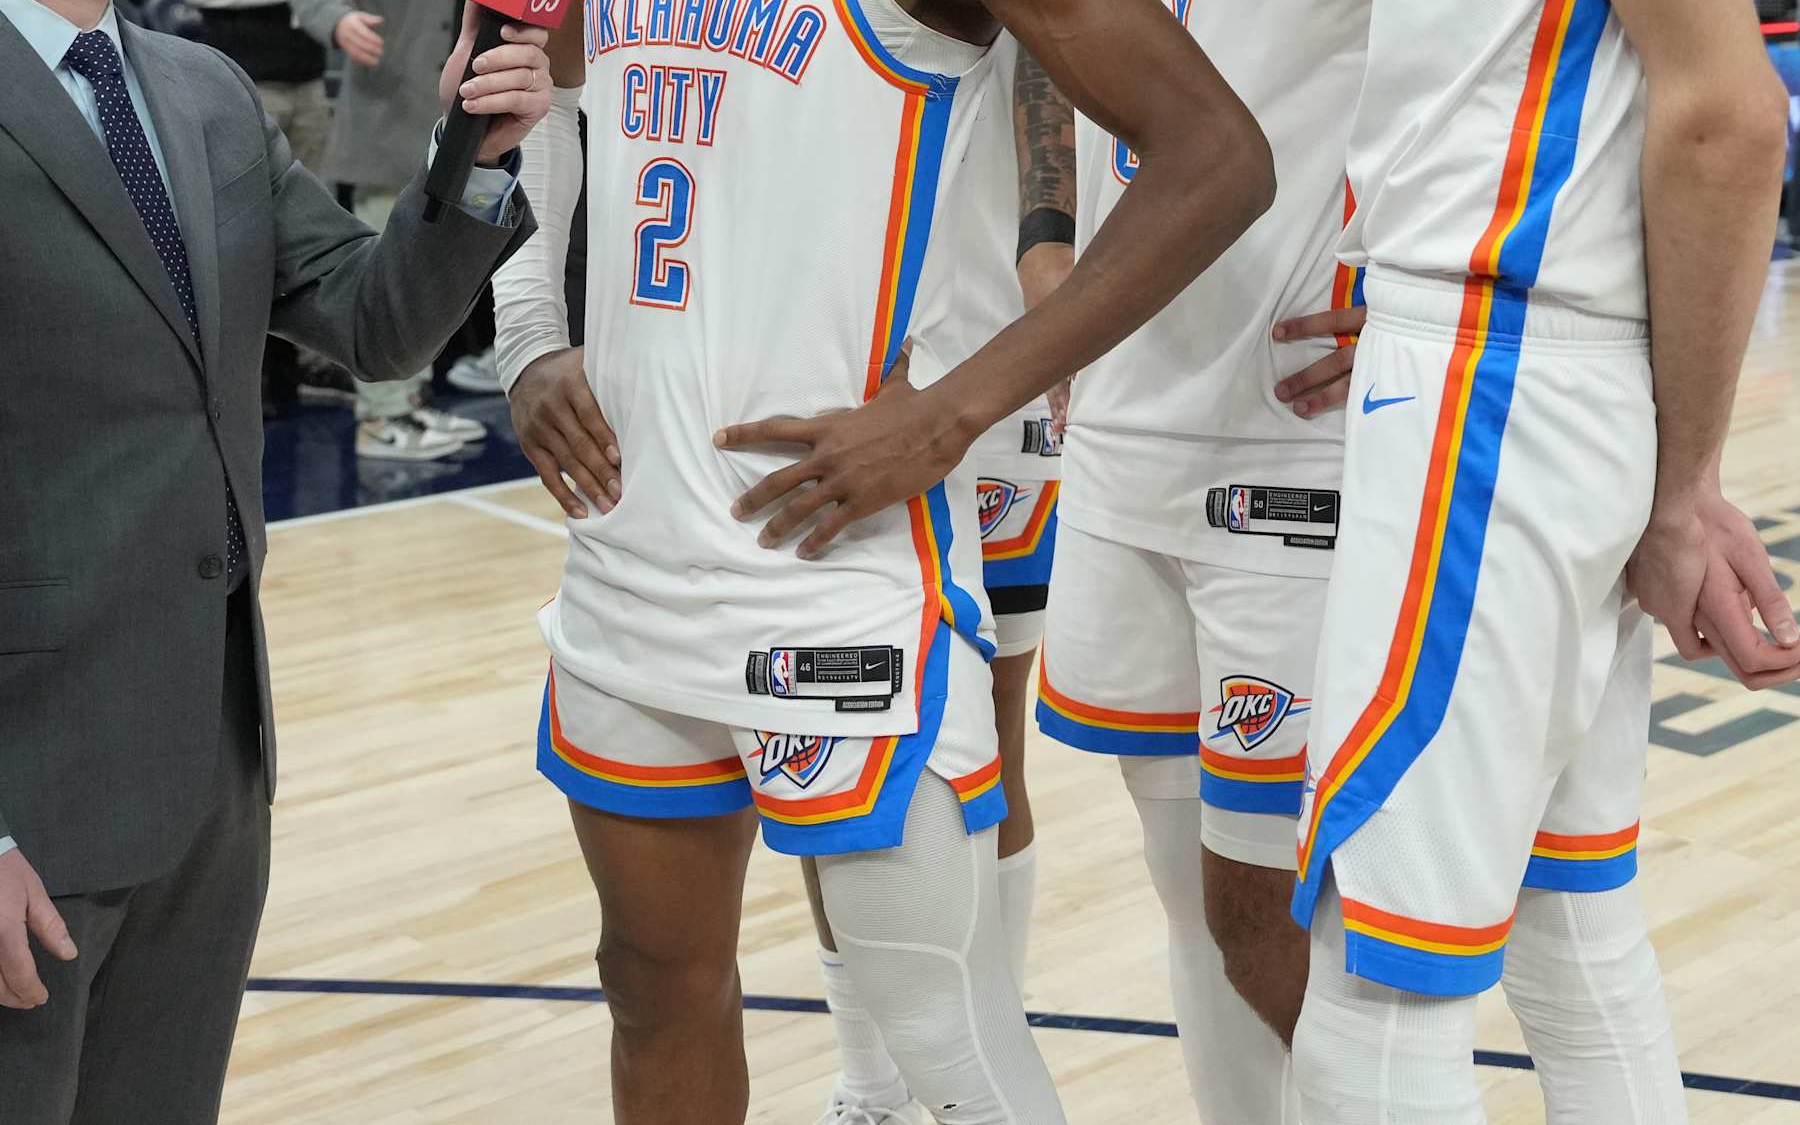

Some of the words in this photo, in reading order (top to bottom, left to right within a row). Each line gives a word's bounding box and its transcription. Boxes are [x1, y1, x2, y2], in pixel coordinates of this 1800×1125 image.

[621, 63, 727, 147] CITY
[629, 156, 696, 311] 2
[1253, 499, 1264, 509] 50
[800, 662, 811, 672] 46
[1219, 694, 1274, 729] OKC
